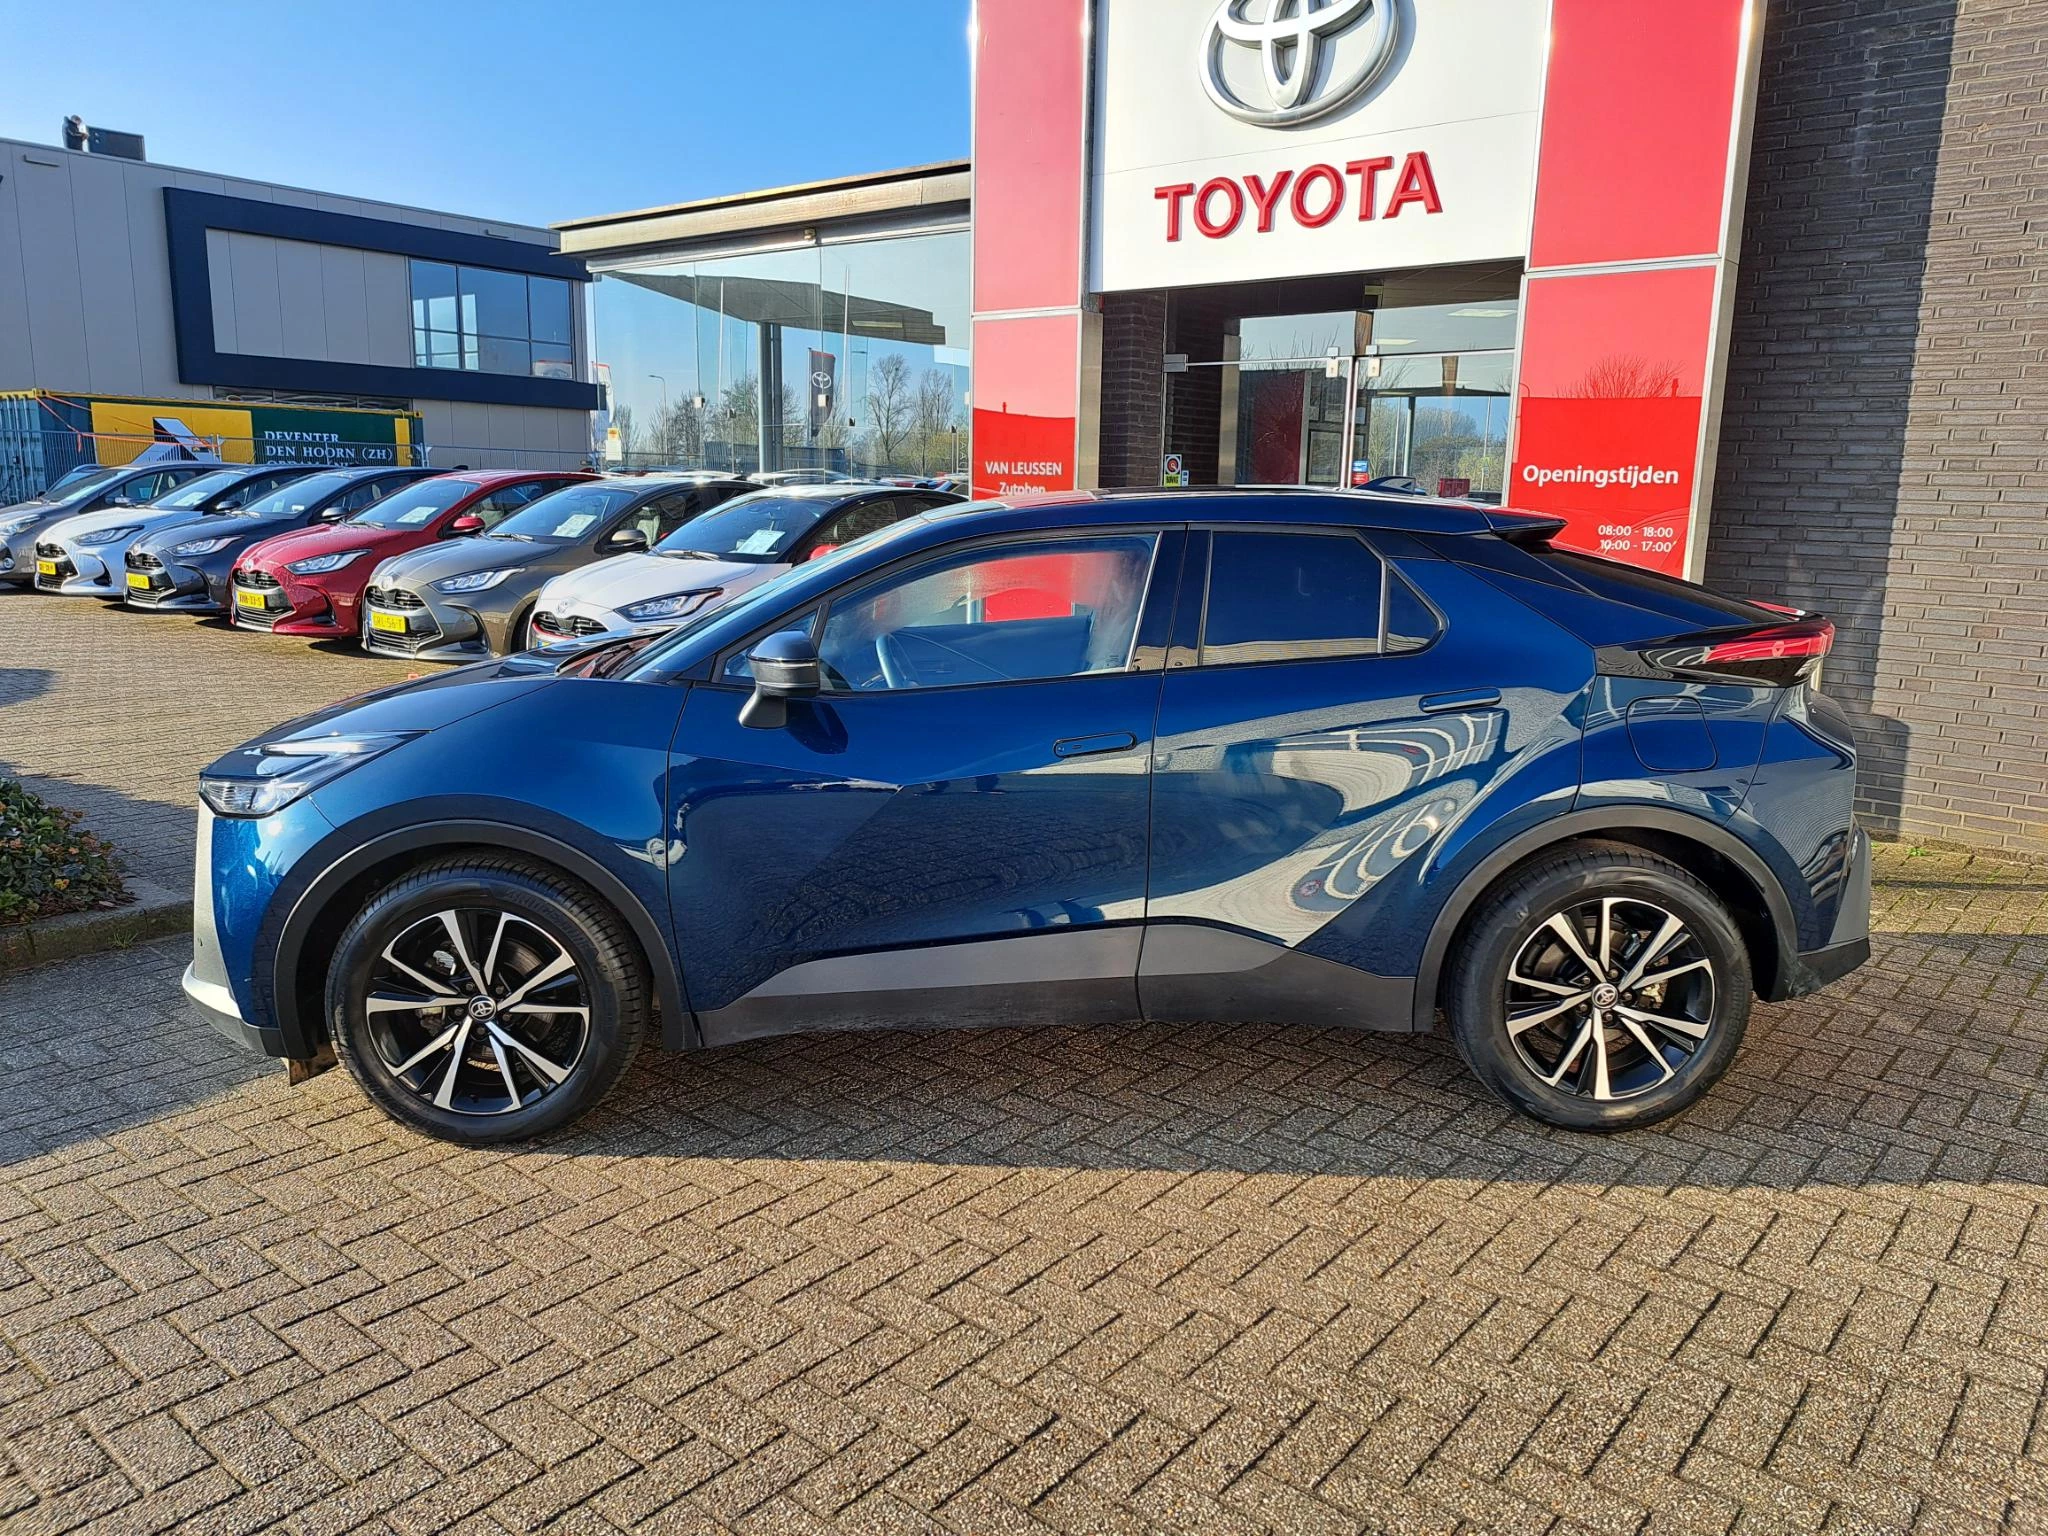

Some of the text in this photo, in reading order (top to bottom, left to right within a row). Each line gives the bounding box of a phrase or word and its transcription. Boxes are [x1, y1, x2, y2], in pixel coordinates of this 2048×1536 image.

[1154, 151, 1443, 242] TOYOTA
[264, 431, 339, 442] DEVENTER
[266, 446, 393, 461] DEN HOORN (ZH)
[985, 461, 1062, 476] VAN LEUSSEN
[1522, 464, 1680, 489] Openingstijden
[999, 481, 1046, 495] Zutphen
[1598, 525, 1632, 536] 08:00
[1642, 526, 1674, 538] 18:00
[1600, 539, 1631, 551] 10:00
[1641, 541, 1672, 553] 17:00
